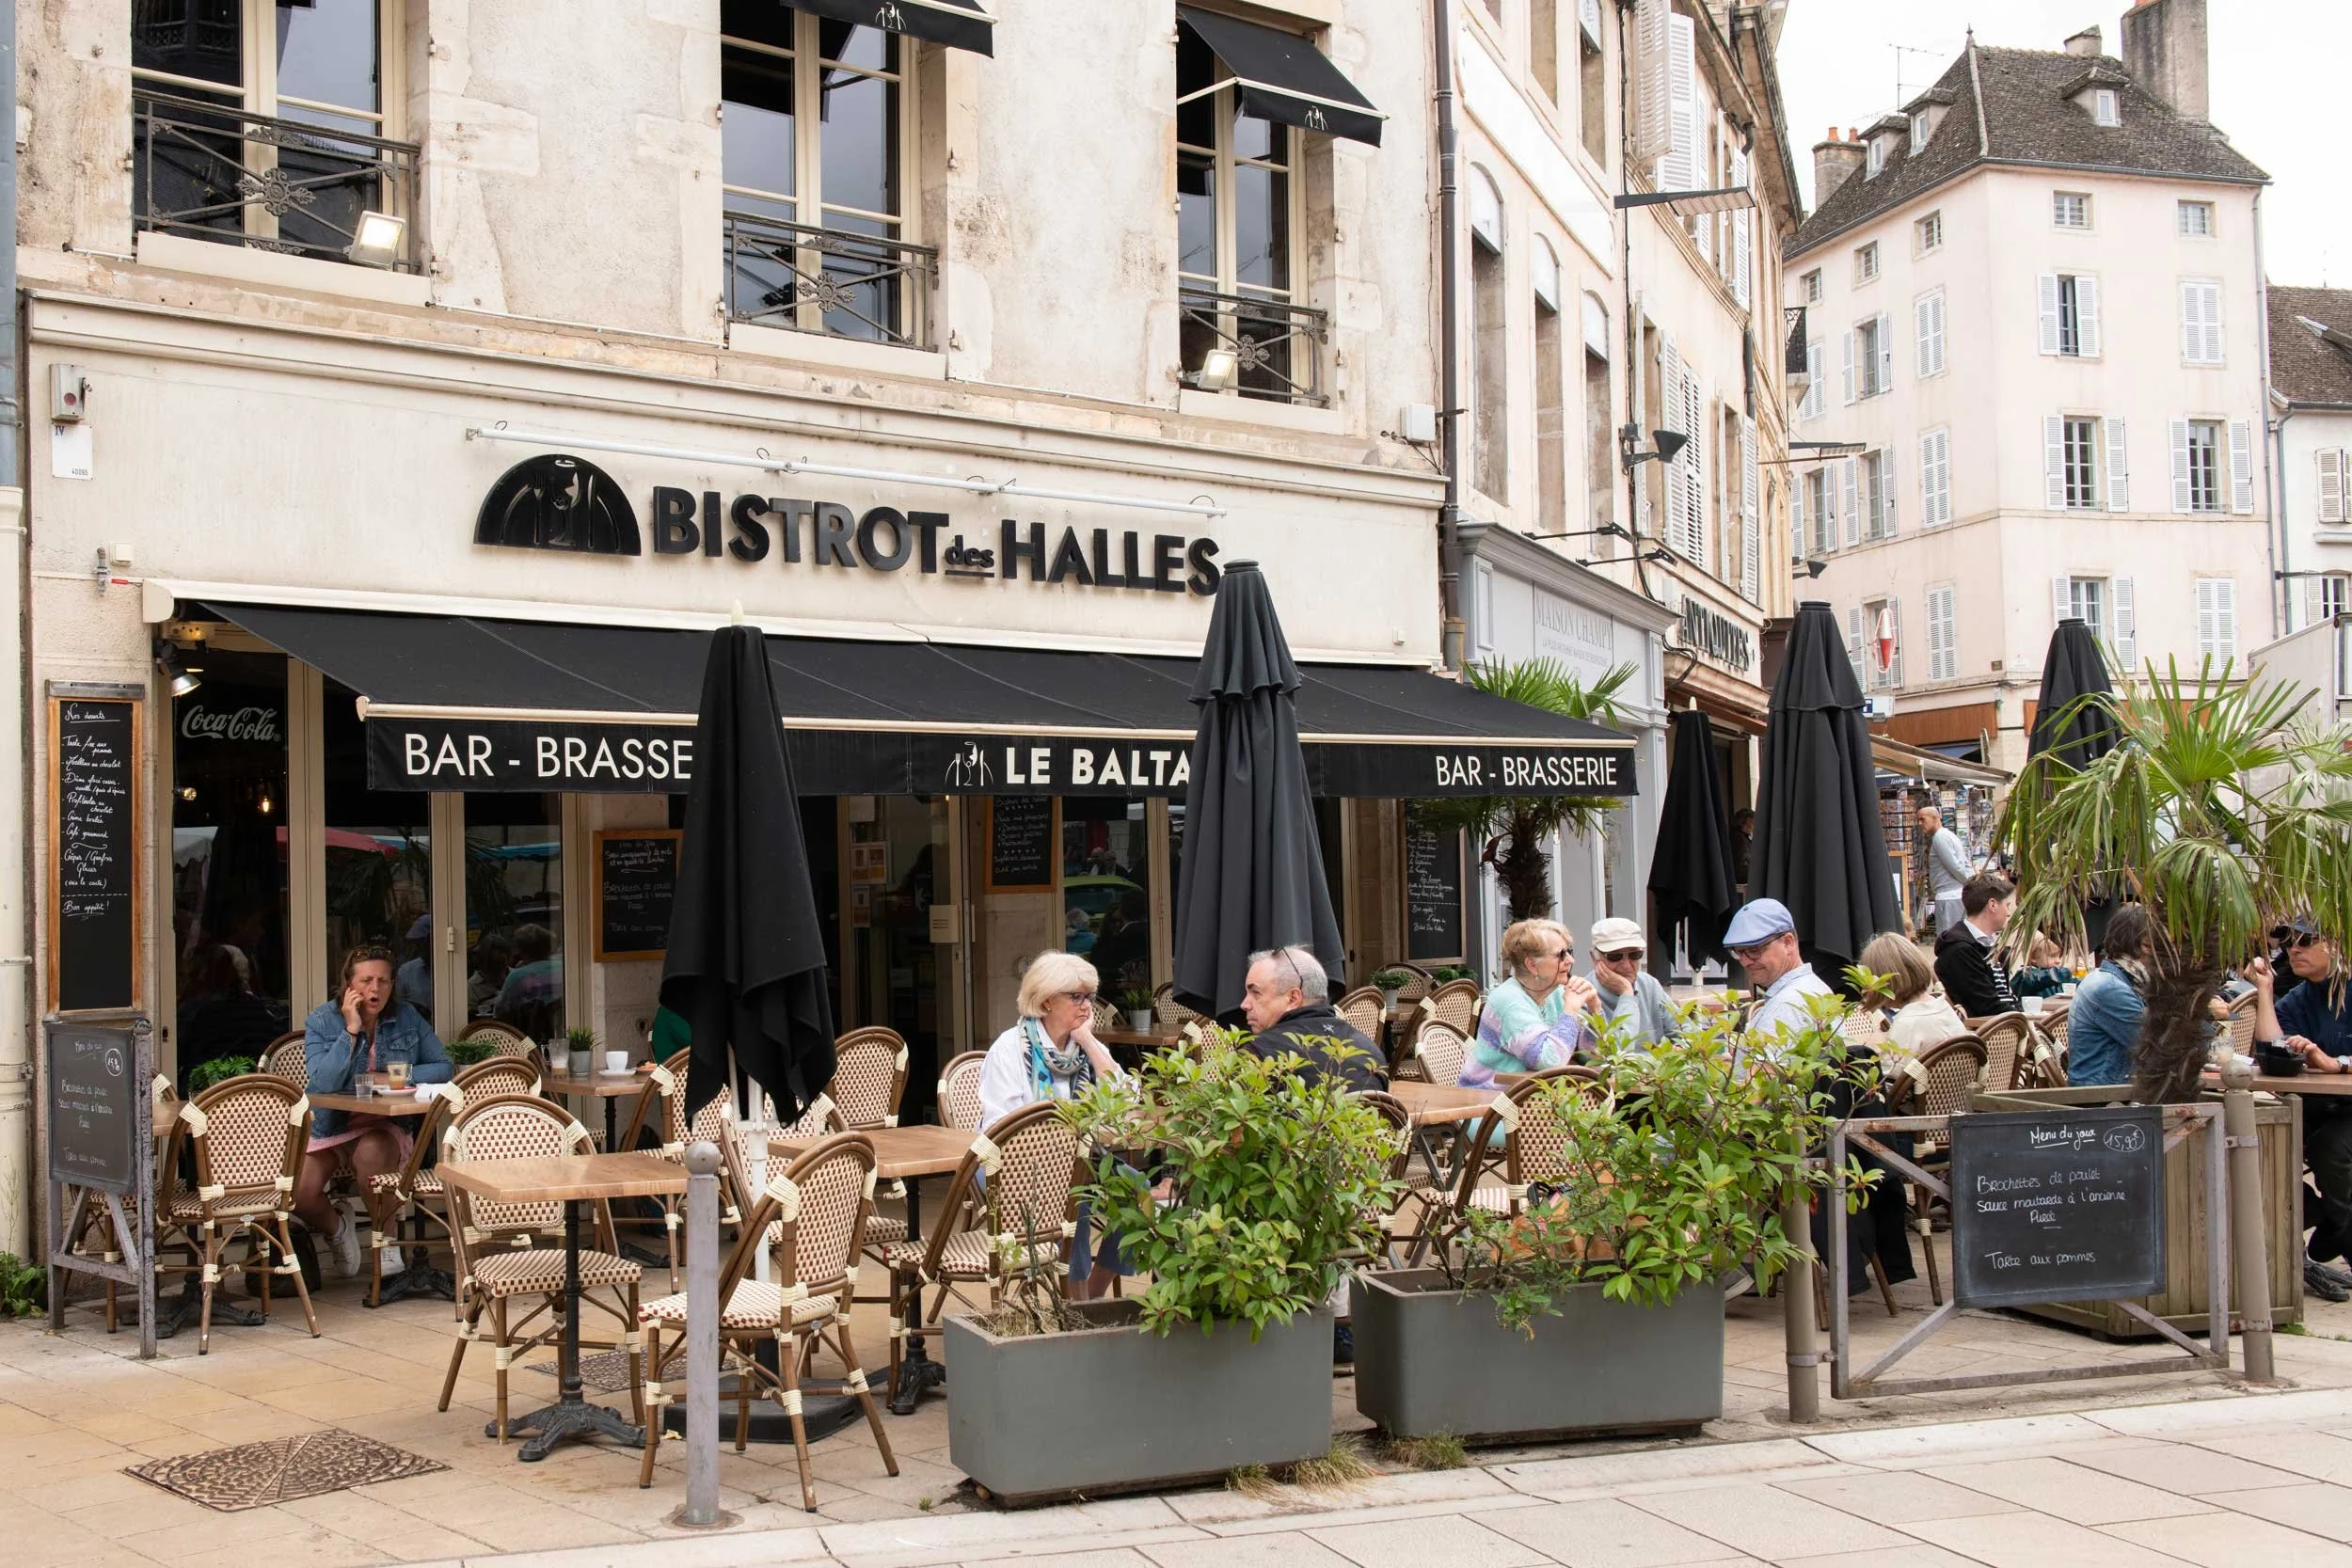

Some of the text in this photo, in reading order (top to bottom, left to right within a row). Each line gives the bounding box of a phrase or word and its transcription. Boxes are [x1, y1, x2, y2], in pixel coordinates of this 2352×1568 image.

[652, 485, 1221, 596] BISTROT des HALLES
[1535, 594, 1613, 651] MAISON CHAMPY
[182, 705, 278, 741] Coca-Cola
[405, 733, 495, 777] BAR
[536, 736, 694, 780] BRASSE
[1006, 747, 1052, 784] LE
[1435, 755, 1484, 786] BAR
[1502, 756, 1618, 786] BRASSERIE
[2030, 1126, 2057, 1144] Menu
[2058, 1124, 2073, 1138] du
[1978, 1167, 2101, 1195] Brochettes de poulet
[2067, 1192, 2075, 1205] à
[1984, 1251, 2097, 1270] Tarte aux pommes
